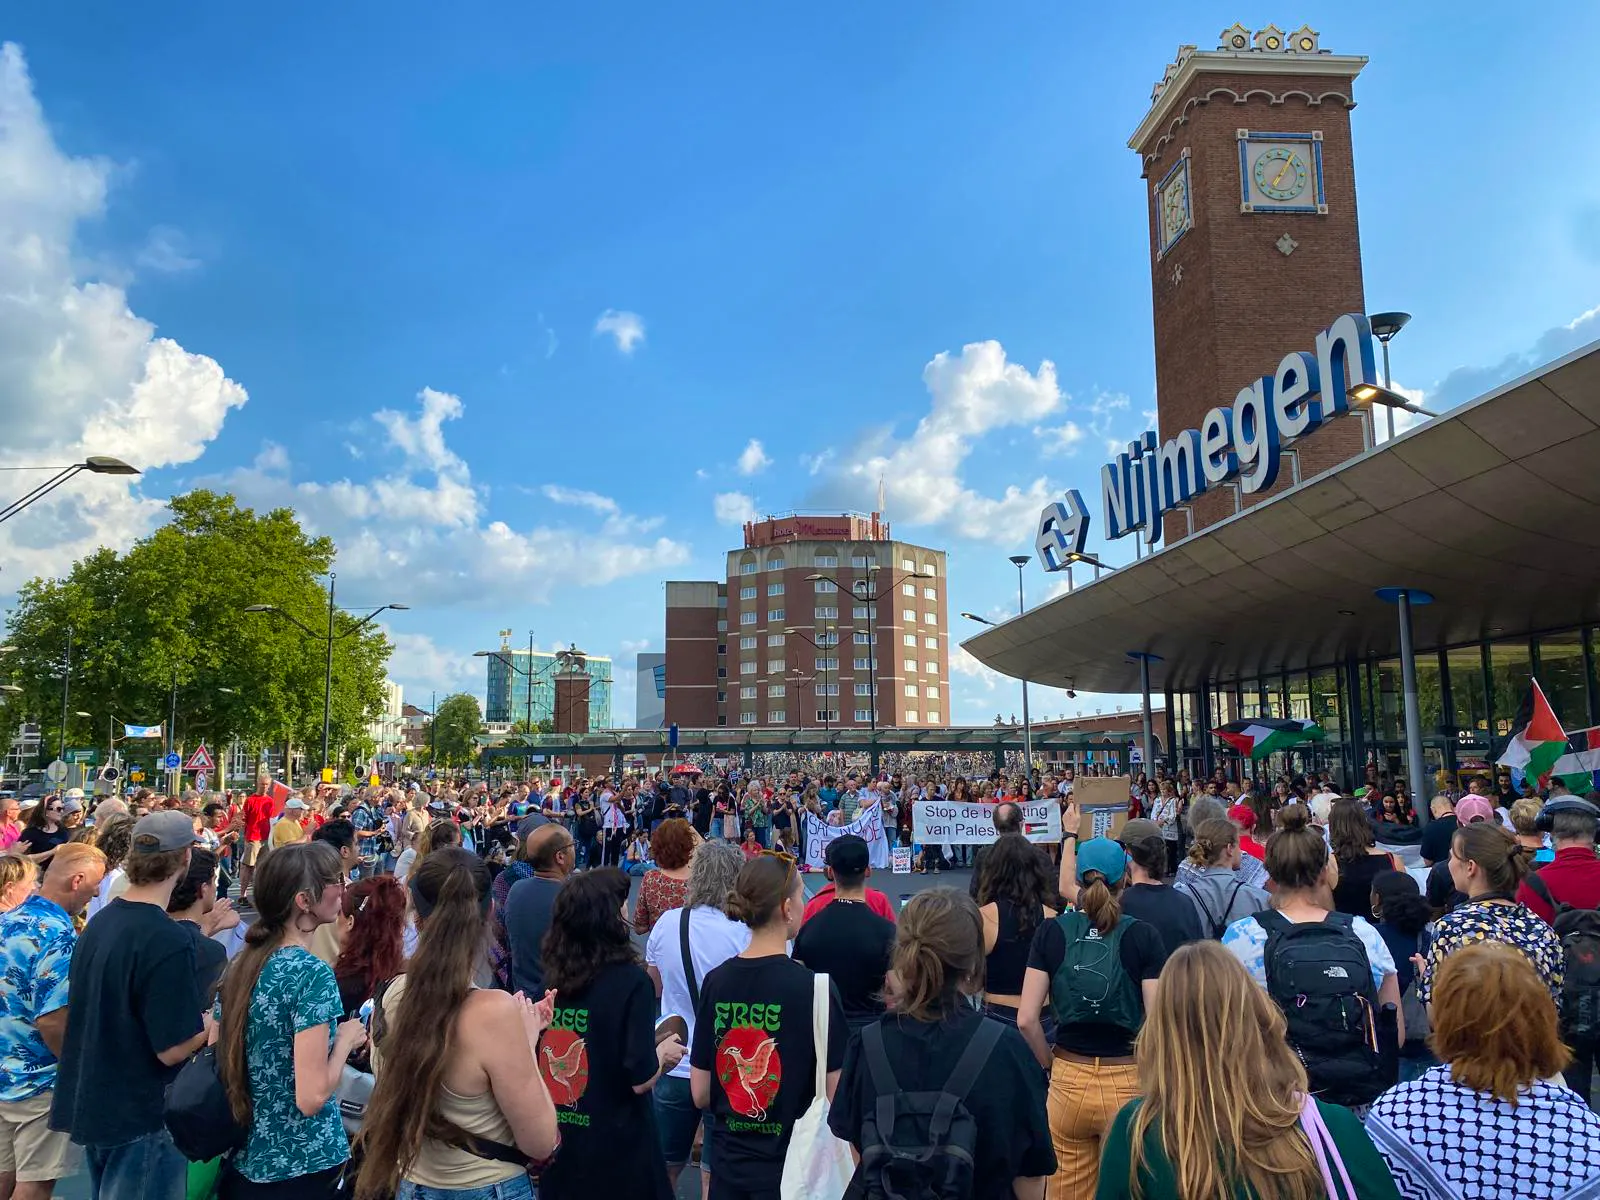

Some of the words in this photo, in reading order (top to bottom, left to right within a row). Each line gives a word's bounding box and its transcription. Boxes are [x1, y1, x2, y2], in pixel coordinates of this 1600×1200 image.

[1100, 313, 1377, 544] Nijmegen
[925, 805, 957, 820] Stop
[961, 807, 979, 819] de
[809, 815, 828, 836] SAY
[926, 825, 951, 836] van
[552, 1008, 589, 1032] REE
[715, 1002, 782, 1032] FREE
